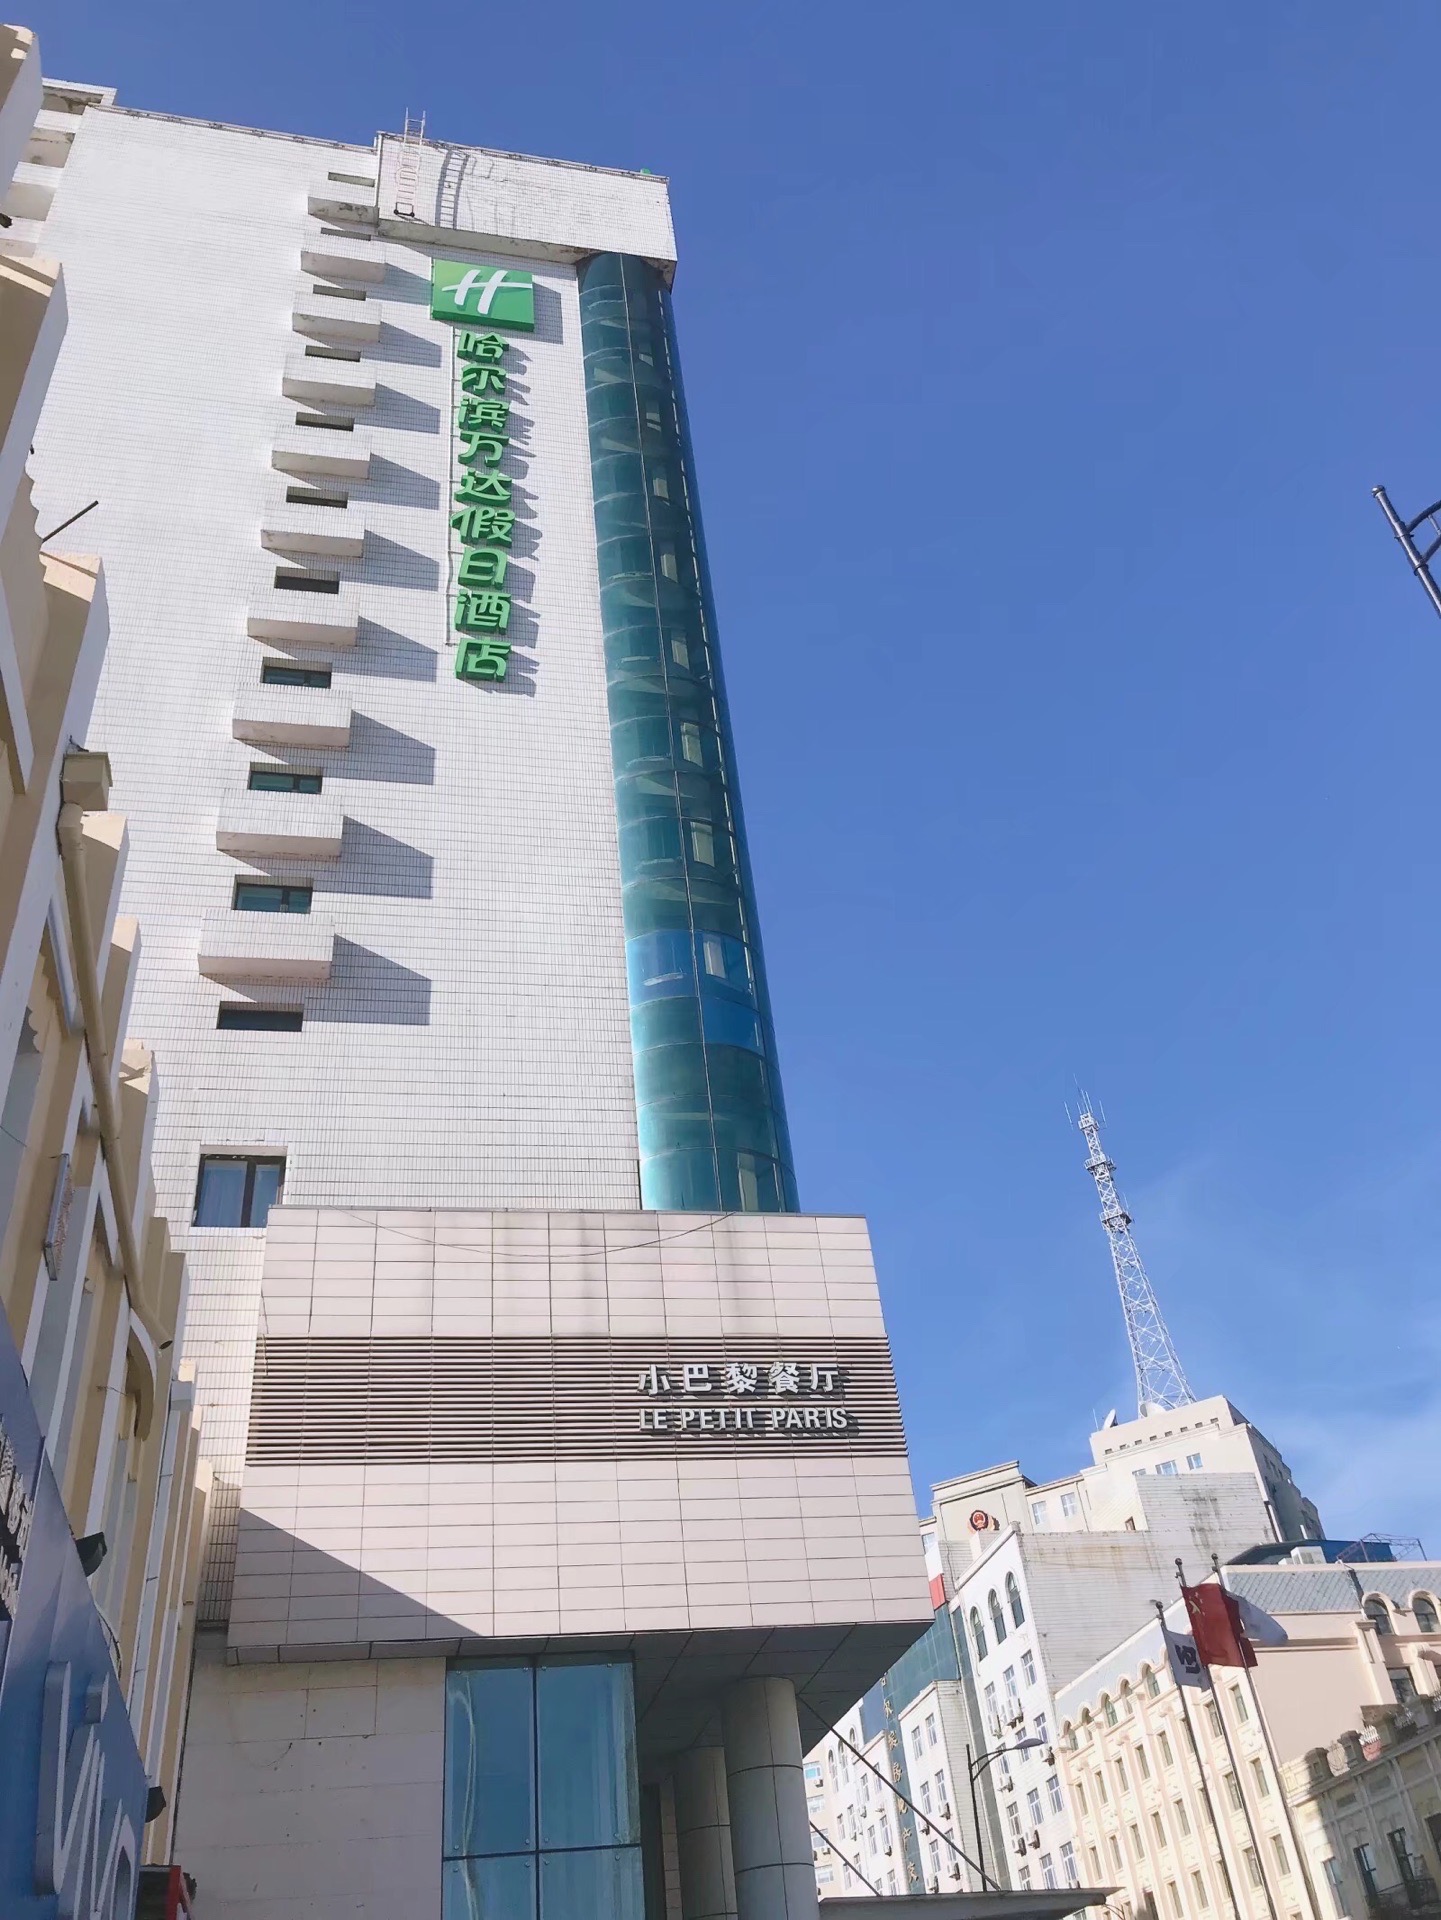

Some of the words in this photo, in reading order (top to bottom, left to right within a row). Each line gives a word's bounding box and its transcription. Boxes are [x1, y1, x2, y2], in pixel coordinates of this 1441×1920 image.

[450, 331, 515, 681] 哈尔滨万达假日酒店
[638, 1362, 840, 1395] 小巴黎餐厅
[639, 1408, 669, 1431] LE
[681, 1408, 757, 1430] PETIT
[770, 1407, 848, 1430] PARIS
